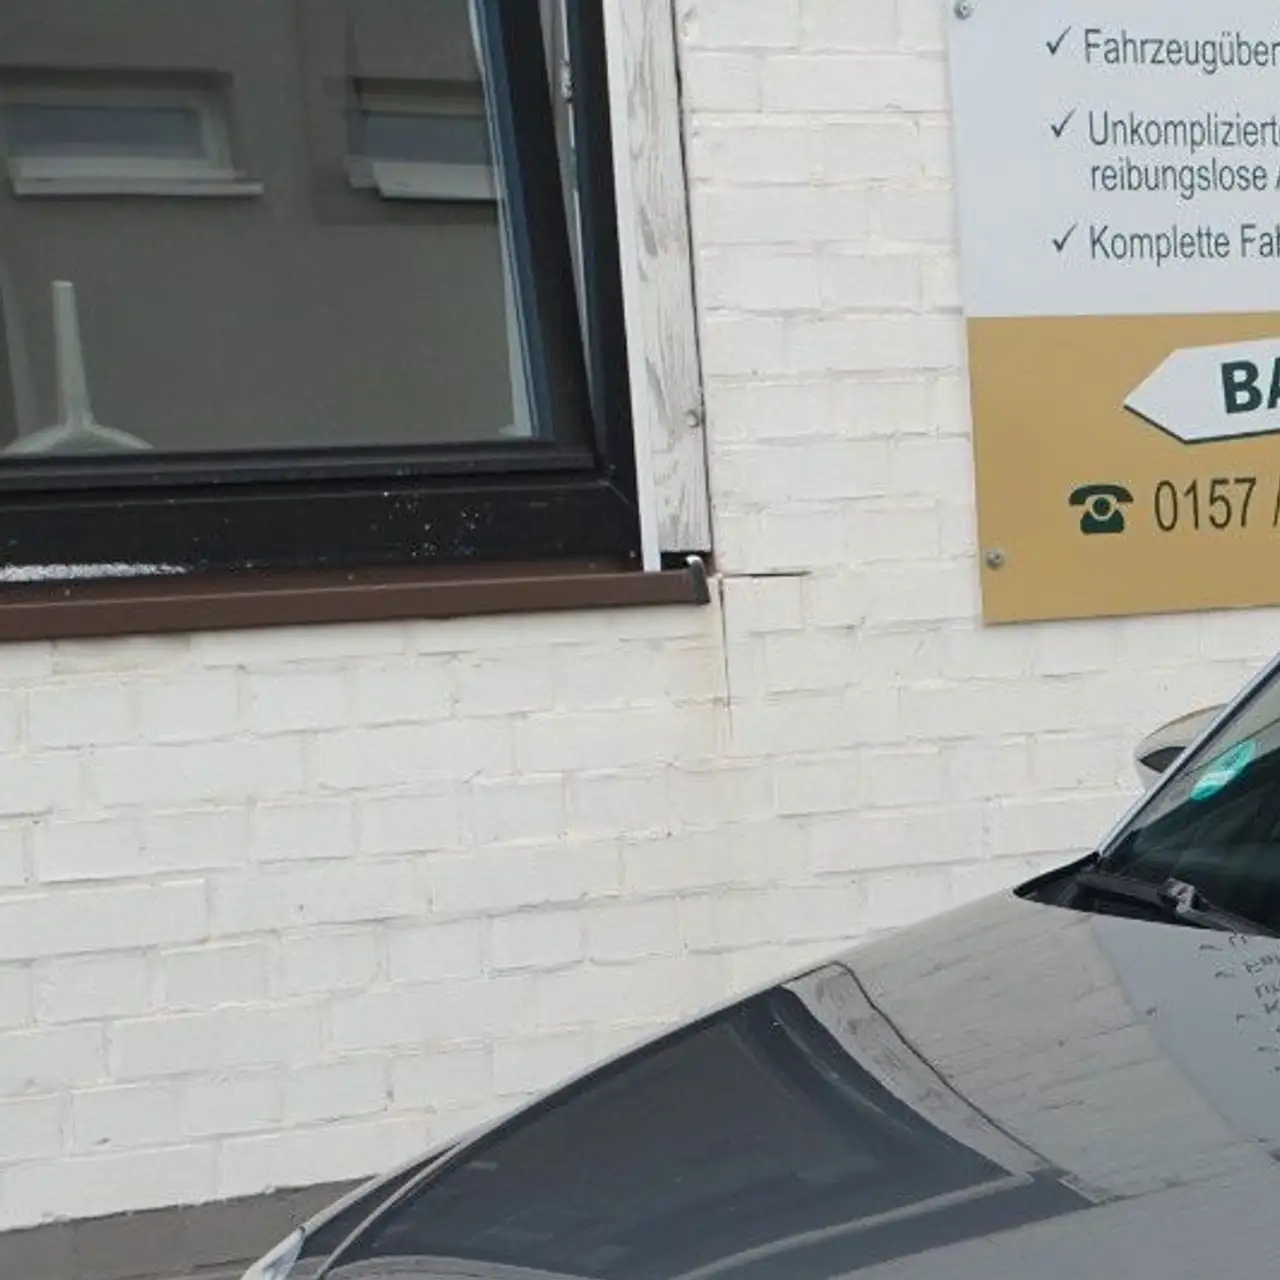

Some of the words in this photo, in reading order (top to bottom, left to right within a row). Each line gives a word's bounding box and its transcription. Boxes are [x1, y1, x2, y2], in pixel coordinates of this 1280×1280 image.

[1090, 158, 1268, 200] reibungslose
[1090, 225, 1231, 266] Komplette
[1153, 478, 1256, 532] 0157
